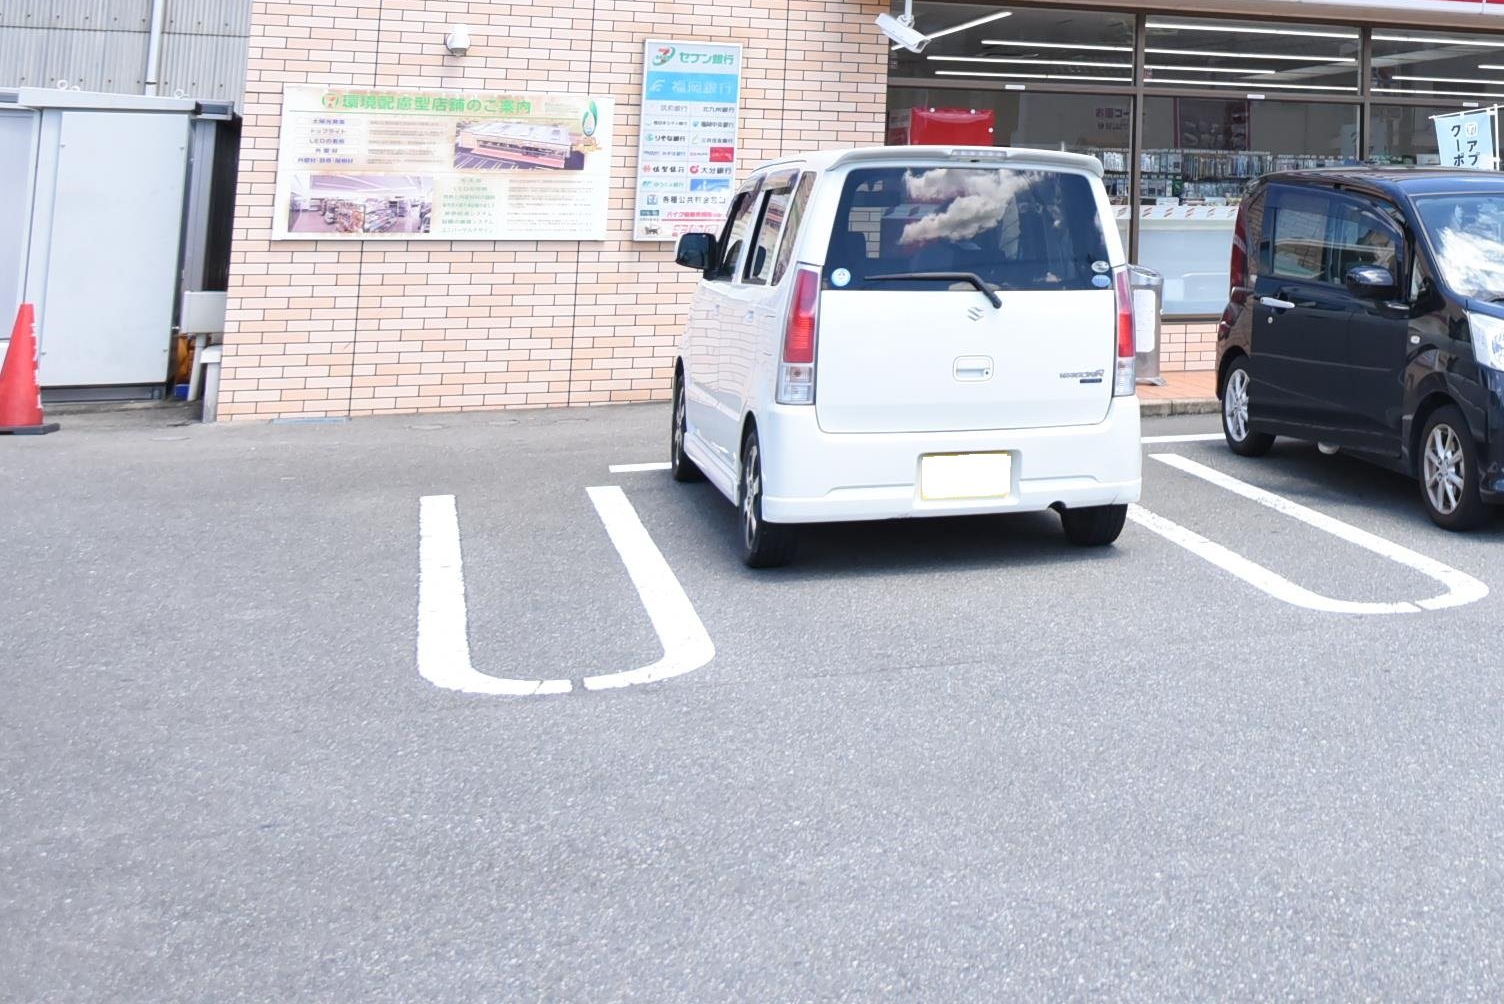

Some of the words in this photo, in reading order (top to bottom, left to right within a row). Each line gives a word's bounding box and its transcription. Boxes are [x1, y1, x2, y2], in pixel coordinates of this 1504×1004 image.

[679, 52, 734, 65] セブン銀行
[672, 79, 732, 94] 福岡銀行
[342, 94, 532, 114] 環境配慮型店舗のご案内
